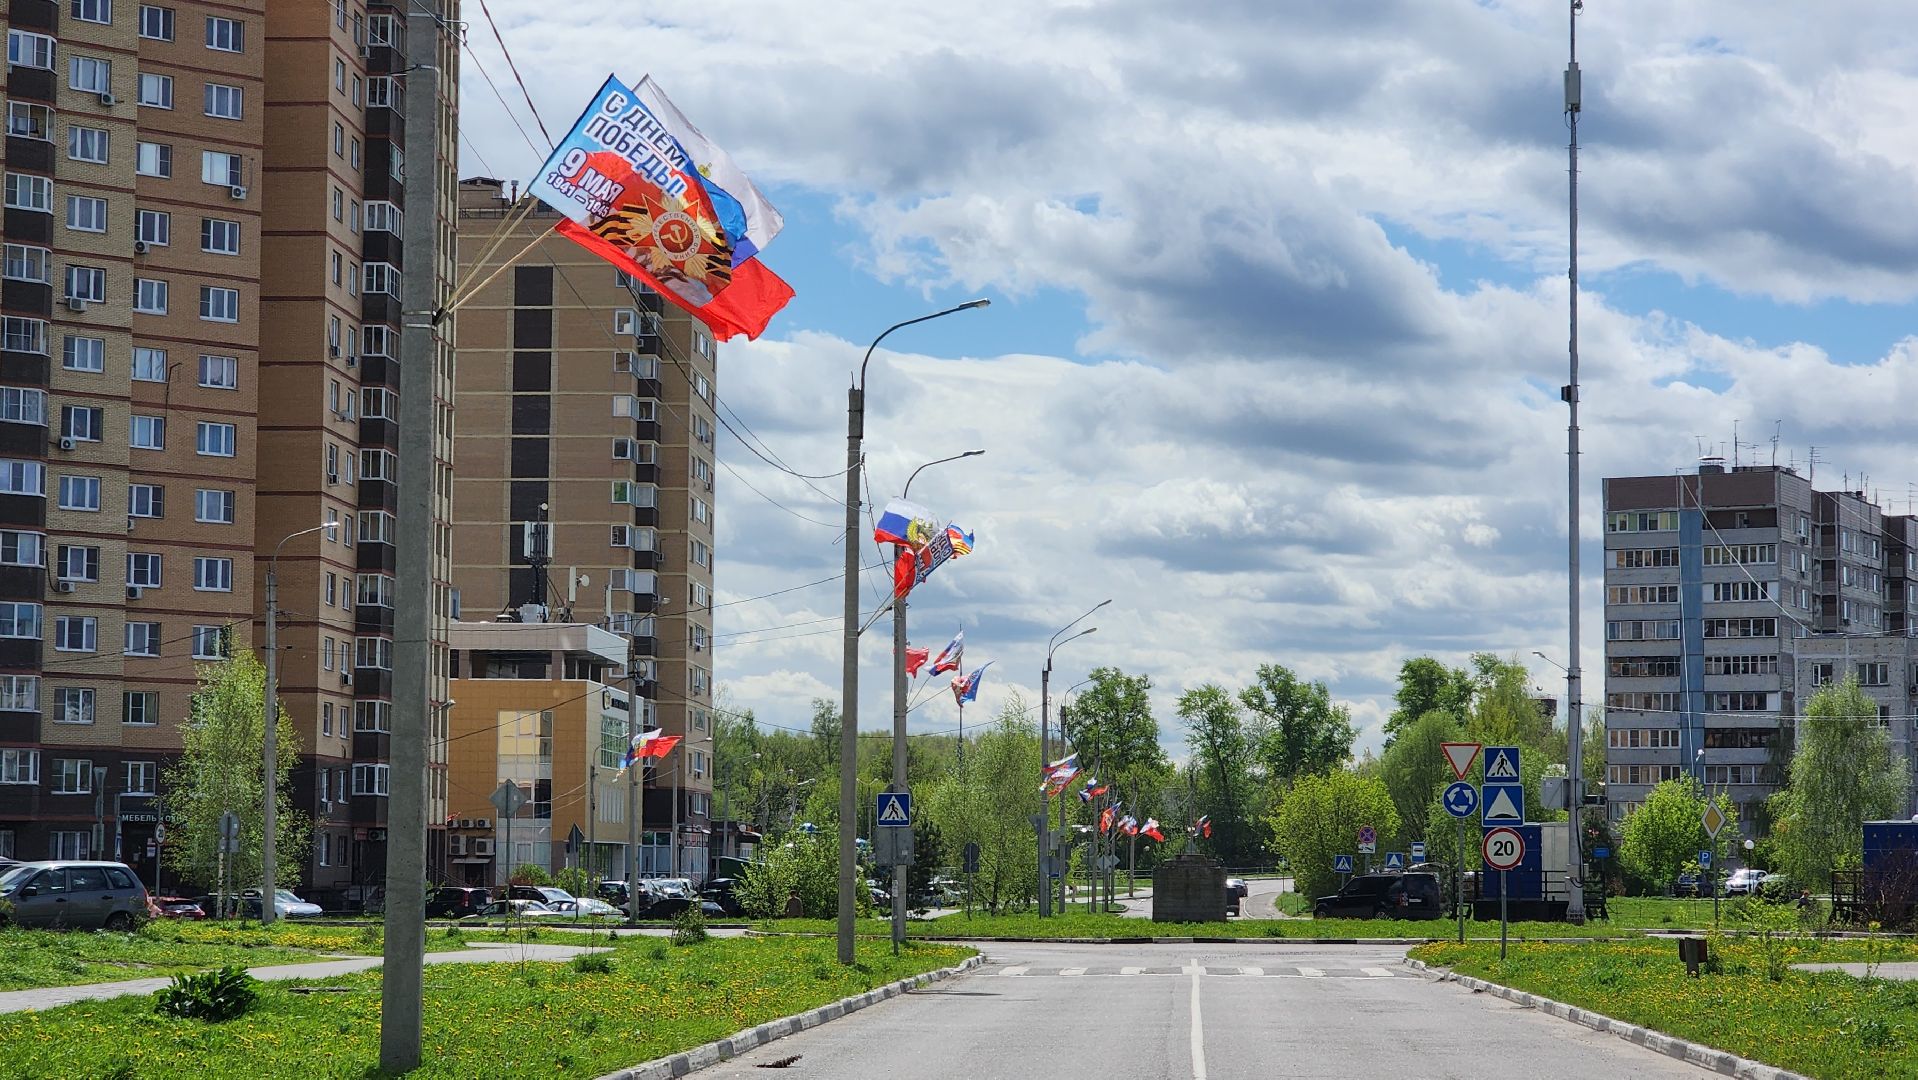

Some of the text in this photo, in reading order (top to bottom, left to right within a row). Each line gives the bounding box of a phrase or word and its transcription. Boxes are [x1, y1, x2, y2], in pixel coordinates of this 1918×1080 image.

[604, 92, 626, 114] С
[585, 115, 687, 197] ПОБЕДЫ!
[558, 147, 625, 203] 9 МАЯ
[547, 172, 577, 198] 1941
[586, 198, 610, 218] 1945
[121, 814, 157, 822] МЕБЕЛЬ
[1493, 840, 1515, 857] 20
[1701, 852, 1709, 862] P
